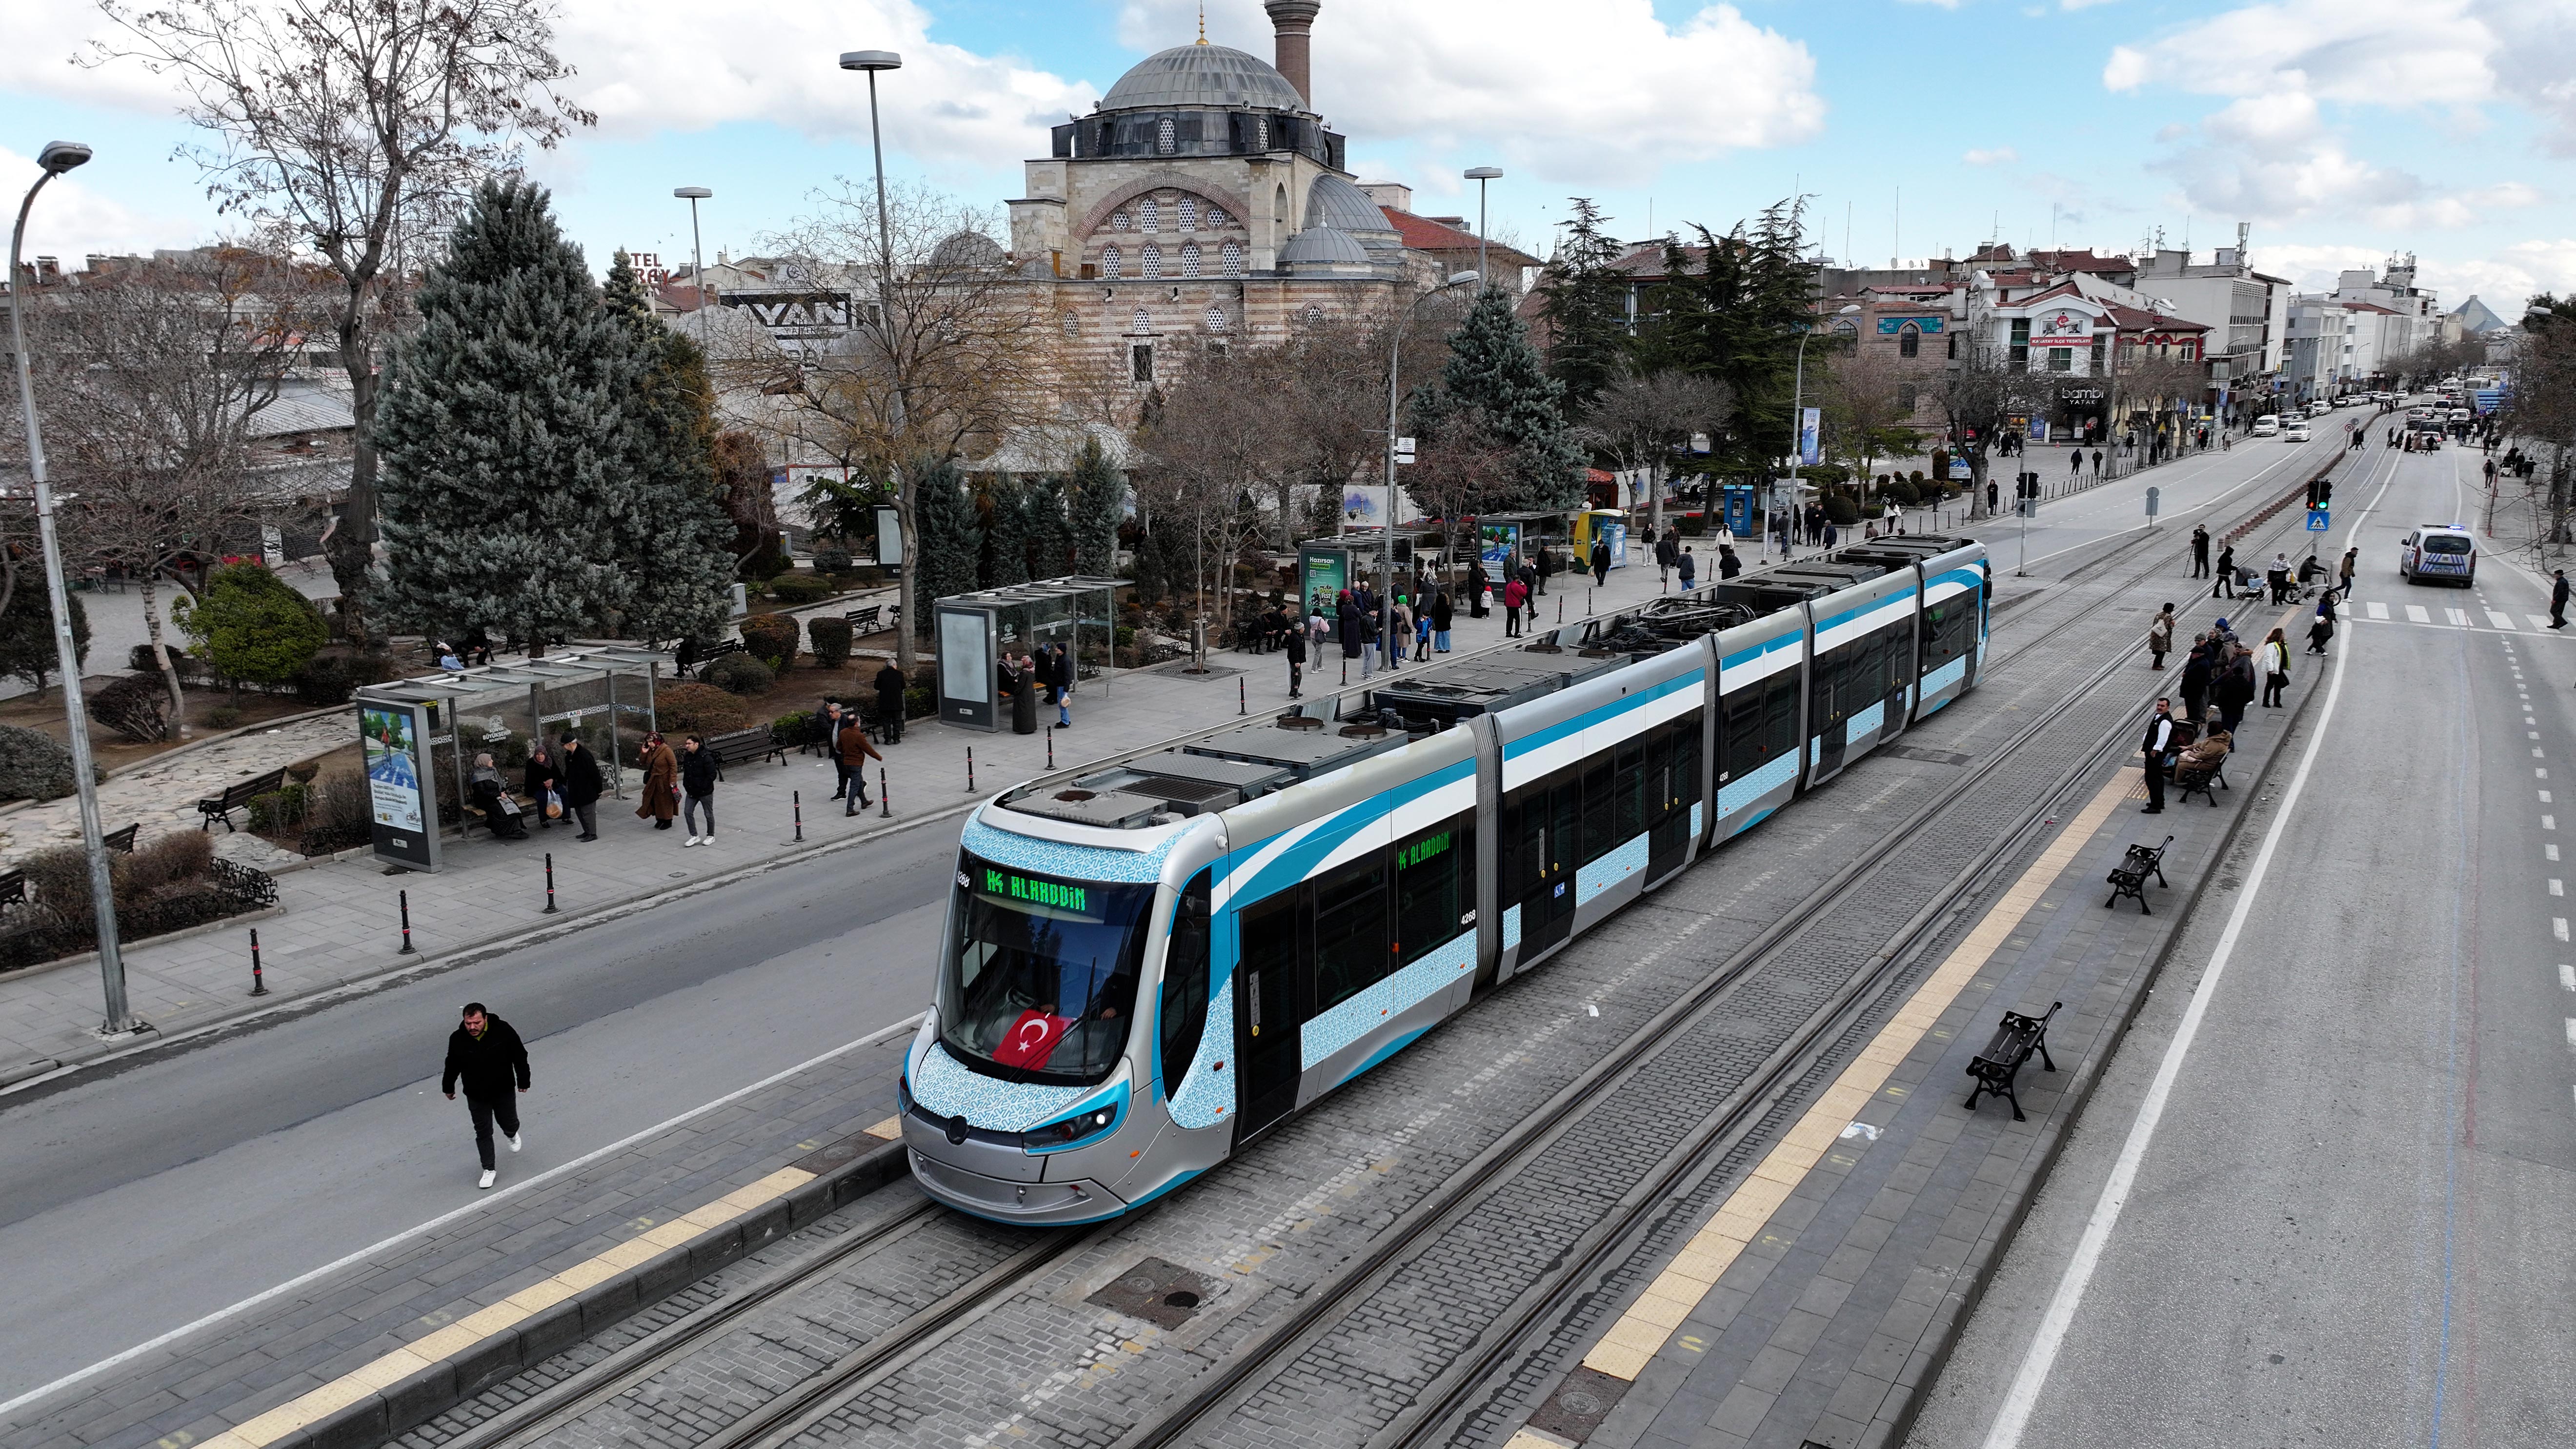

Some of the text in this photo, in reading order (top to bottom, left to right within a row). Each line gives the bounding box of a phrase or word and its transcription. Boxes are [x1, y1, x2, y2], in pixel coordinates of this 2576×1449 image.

[631, 253, 662, 266] TEL
[634, 268, 670, 284] RAY
[1461, 909, 1476, 925] 4268
